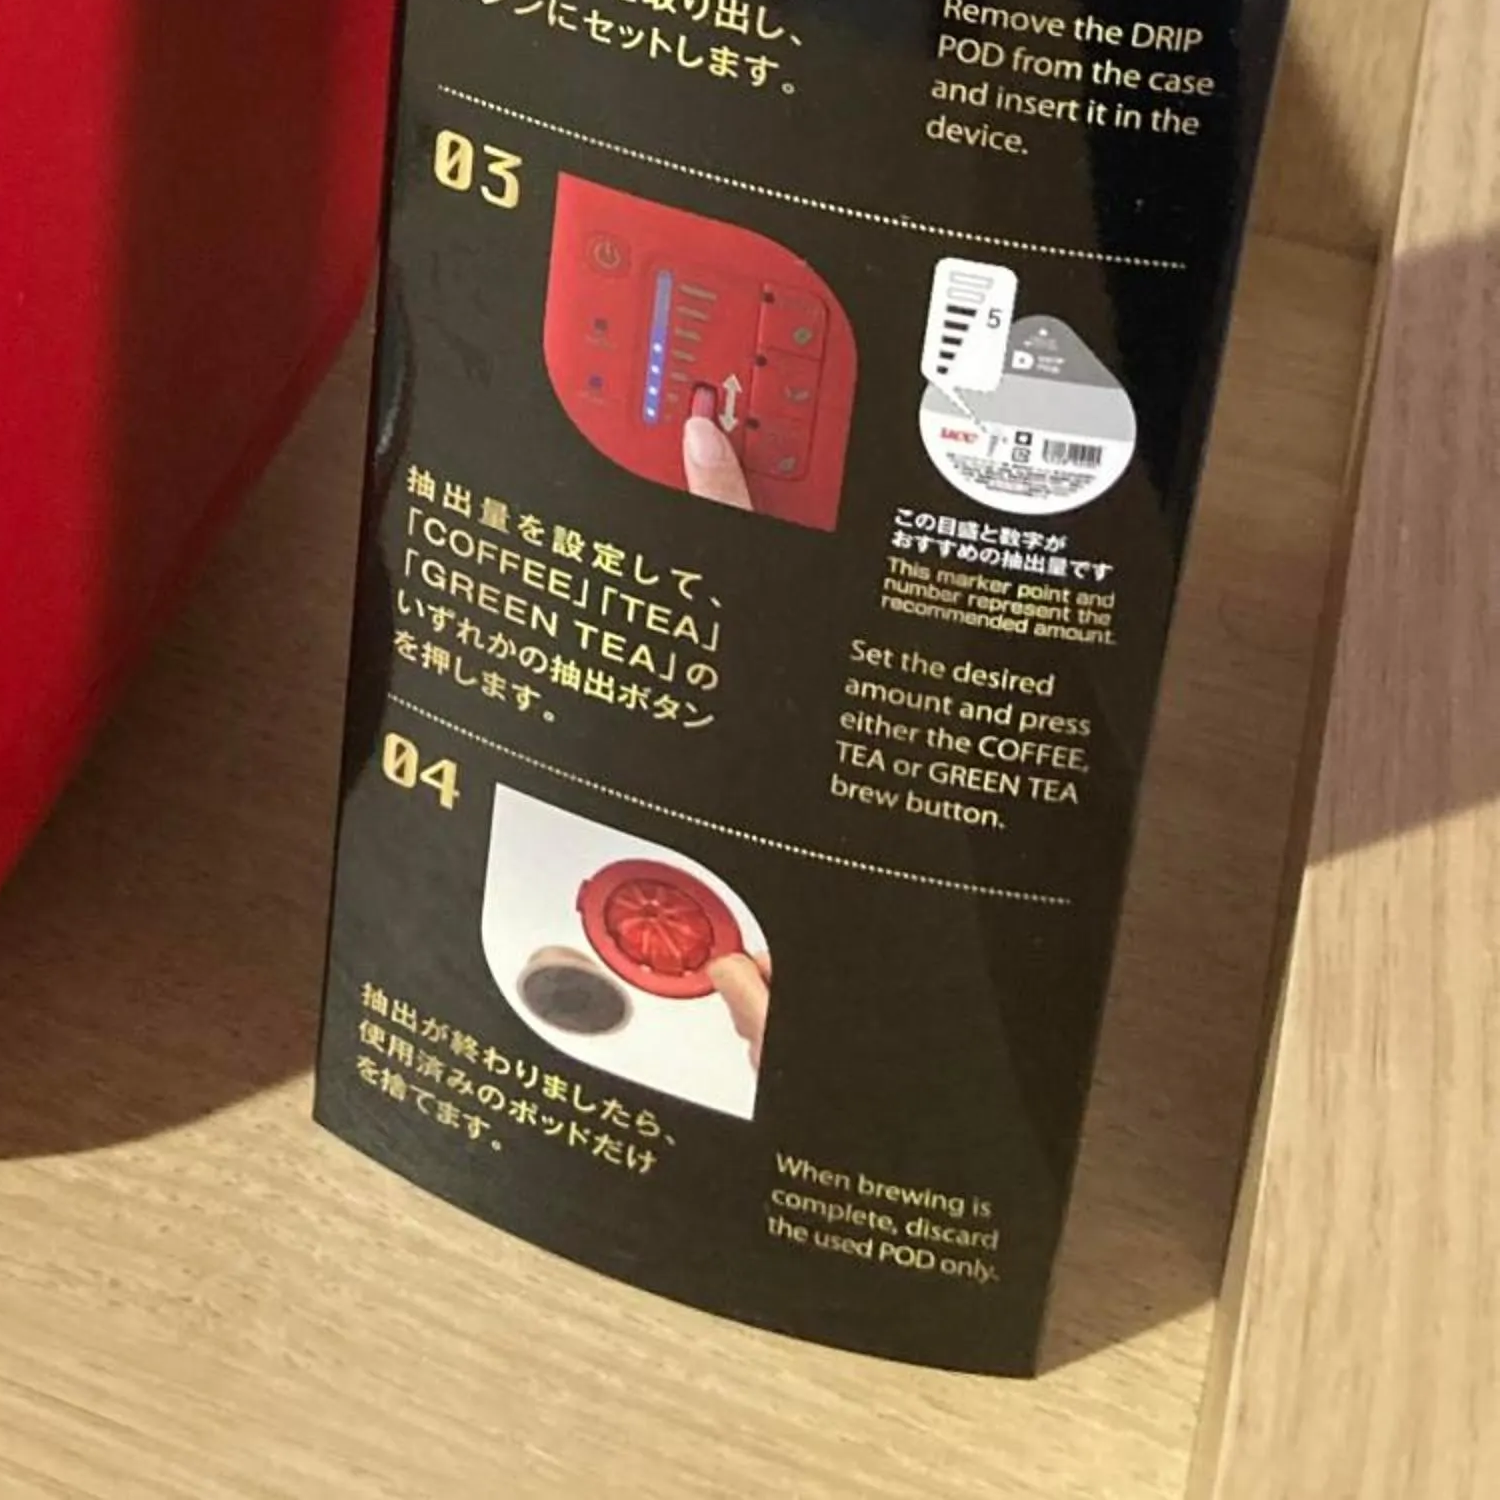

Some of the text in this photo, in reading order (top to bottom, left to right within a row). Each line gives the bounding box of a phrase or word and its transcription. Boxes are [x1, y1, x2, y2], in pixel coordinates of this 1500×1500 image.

[937, 33, 1216, 96] POD from the case
[1074, 16, 1124, 46] the
[1131, 22, 1204, 54] DRIP
[925, 115, 1029, 155] device.
[931, 79, 1200, 137] and insert it in the
[433, 128, 524, 210] 03
[986, 308, 1002, 330] 5
[406, 464, 722, 609] 抽出量を設定して、
[891, 529, 1114, 582] おすすめの抽出量です
[883, 576, 1112, 626] number represent the
[886, 556, 1116, 609] This marker point and
[881, 596, 1117, 646] recommended amount.
[393, 629, 556, 723] を押します。
[396, 588, 716, 728] いずれかの抽出ボタン
[850, 638, 1056, 698] Set the desired
[839, 710, 920, 744] either
[926, 727, 972, 754] the
[844, 676, 1092, 737] amount and press
[381, 731, 461, 811] 04
[830, 773, 1006, 829] brew button.
[835, 740, 1080, 805] TEA or GREEN TEA
[361, 981, 676, 1146] 抽出が終わりましたら、
[356, 1054, 502, 1151] を捨てます。
[359, 1019, 658, 1174] 使用済みのポッドだけ
[776, 1151, 993, 1218] When brewing is
[767, 1215, 1001, 1284] the used POD only.
[770, 1187, 1000, 1250] complete, discard
